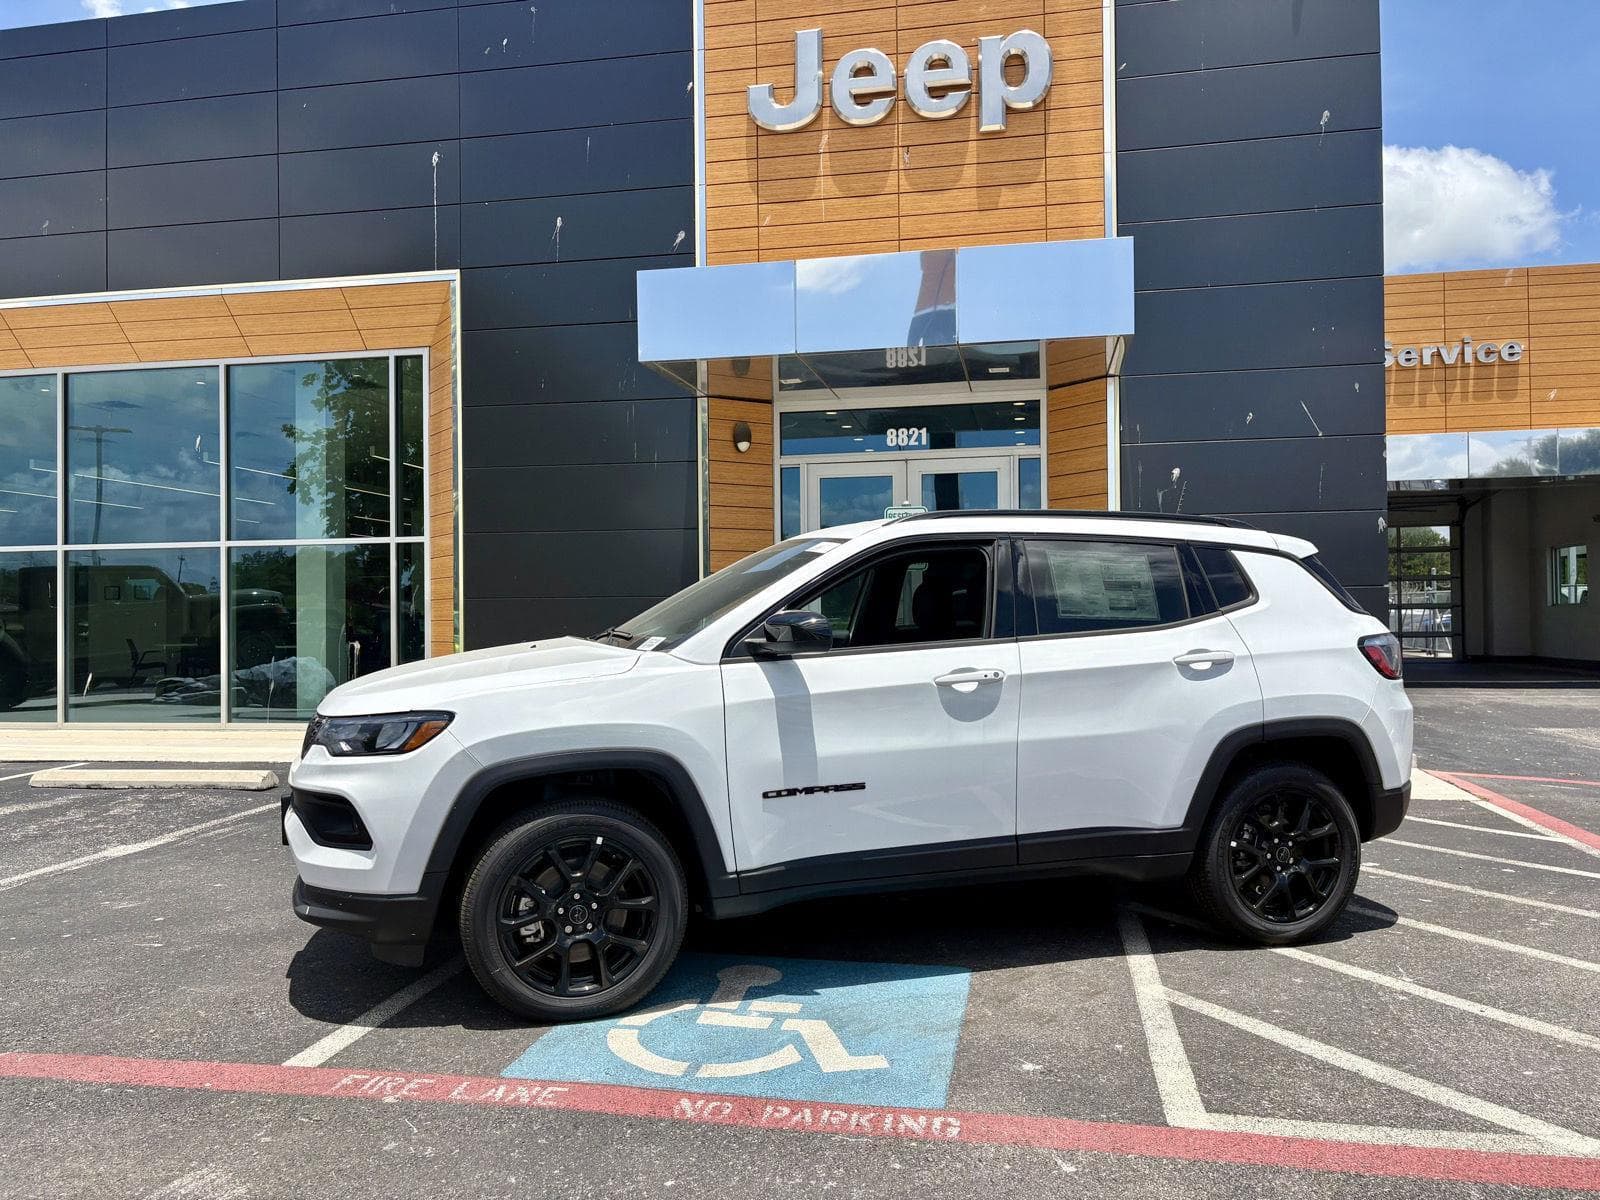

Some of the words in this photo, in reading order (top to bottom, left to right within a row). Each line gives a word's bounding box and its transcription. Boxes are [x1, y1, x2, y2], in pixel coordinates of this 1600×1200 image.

[746, 27, 1053, 134] Jeep
[886, 427, 927, 447] 8821
[762, 782, 866, 799] COMPASS
[331, 1074, 434, 1097] FIRE
[448, 1081, 569, 1105] LANE
[673, 1098, 732, 1119] NO
[758, 1105, 962, 1137] PARKING
